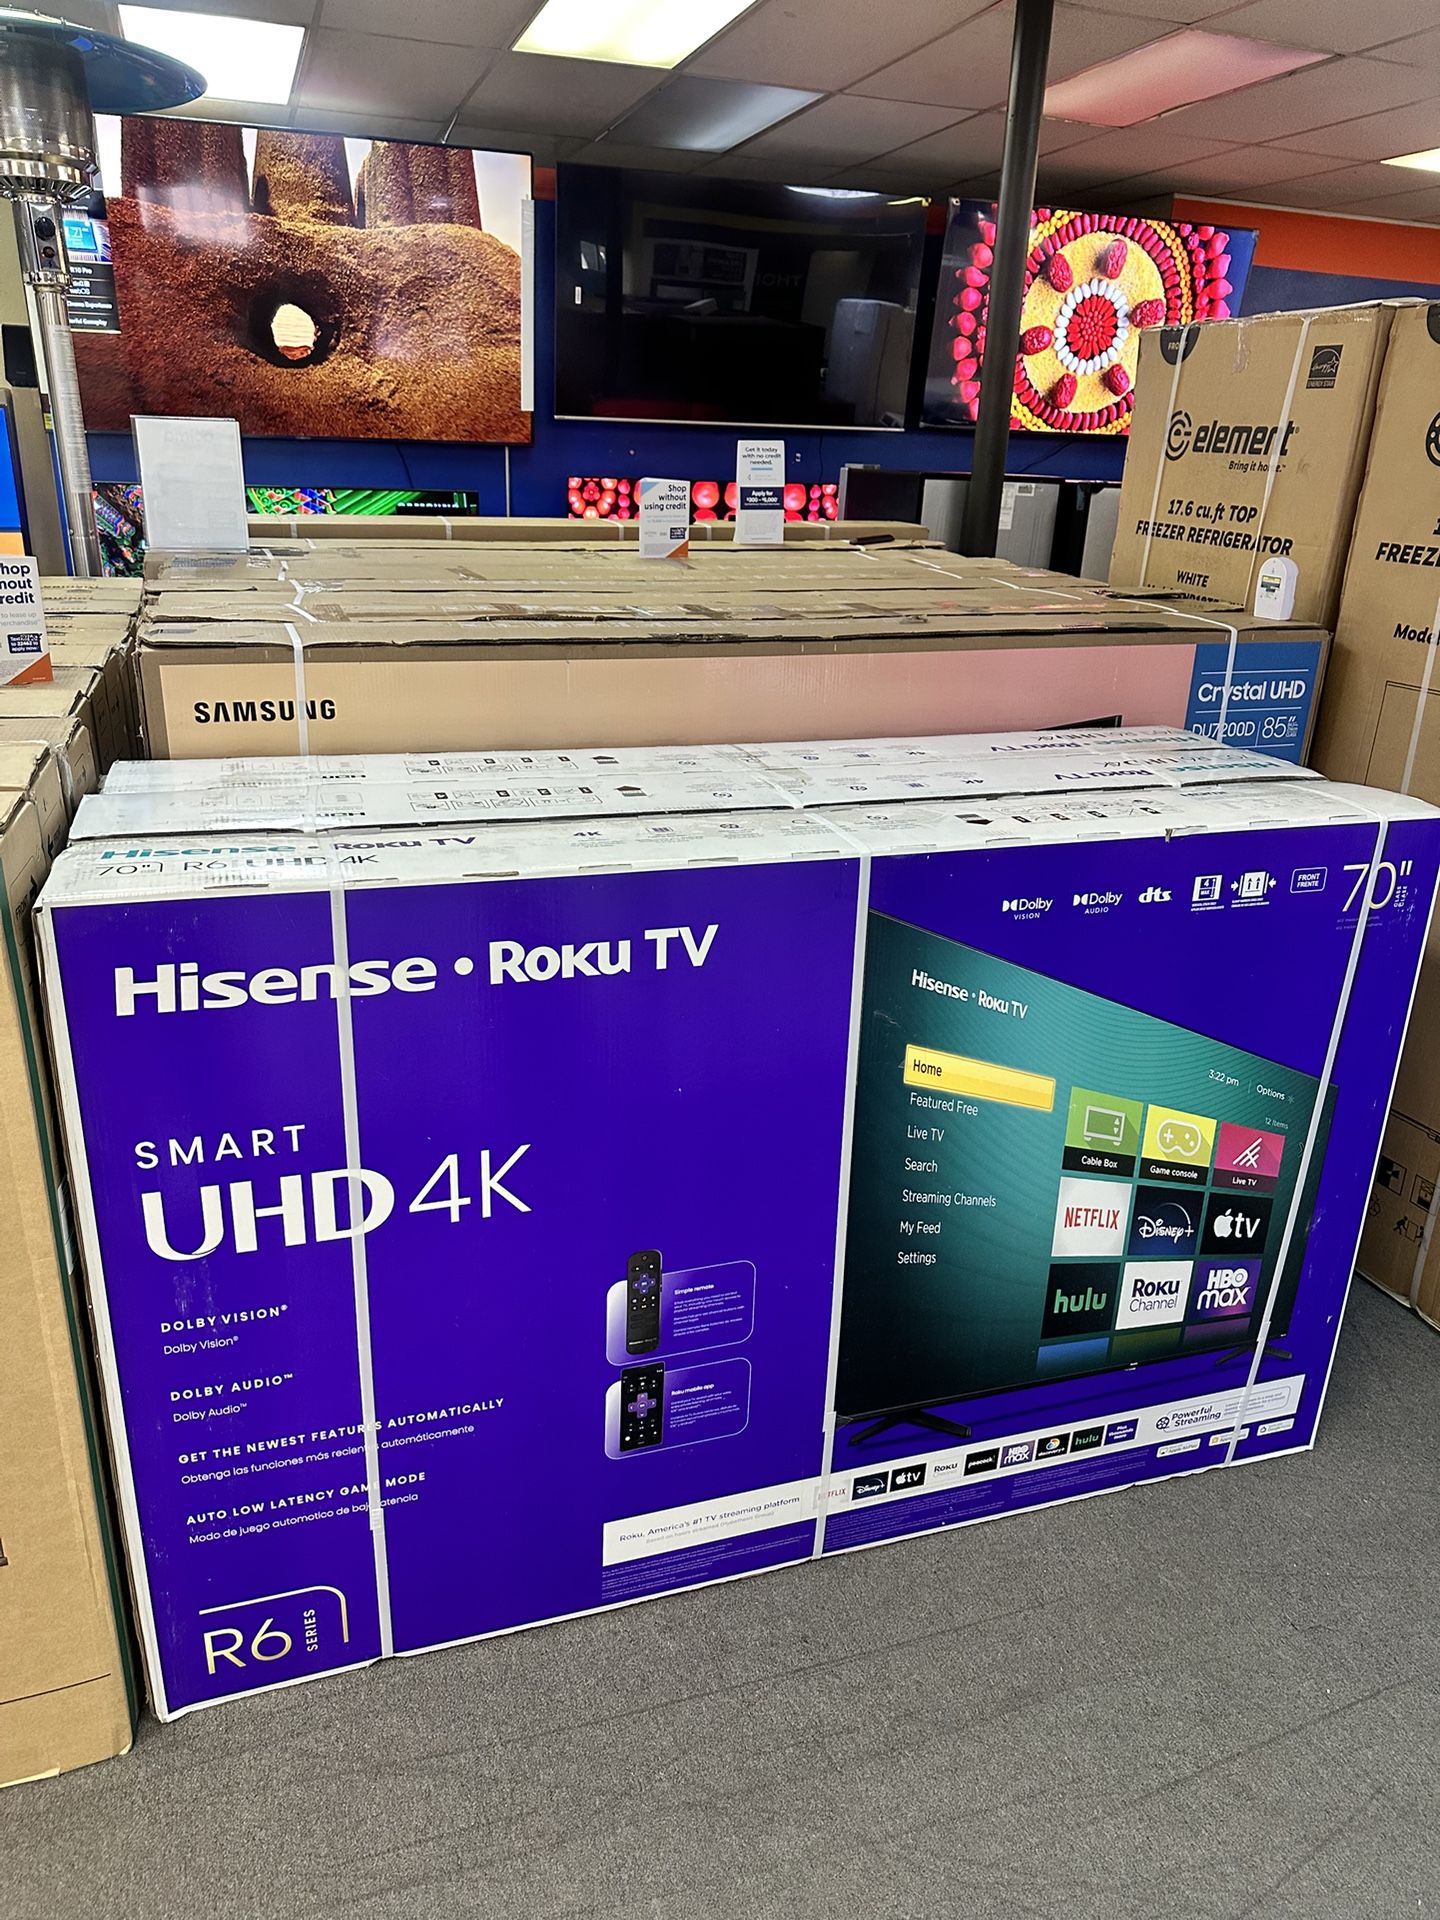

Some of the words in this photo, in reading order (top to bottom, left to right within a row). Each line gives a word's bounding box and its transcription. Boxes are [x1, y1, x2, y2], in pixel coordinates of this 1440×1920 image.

[1229, 460, 1249, 473] Bring
[658, 493, 687, 501] without
[668, 484, 687, 494] Shop
[644, 502, 664, 511] using
[666, 502, 687, 510] credit
[1168, 499, 1194, 516] 17.6
[1196, 503, 1225, 524] cu.ft
[1228, 505, 1258, 523] TOP
[1136, 520, 1184, 541] FREEZER
[1186, 527, 1293, 555] REFRIGERATOR
[1177, 570, 1209, 587] WHITE
[1197, 681, 1267, 702] Crystal
[1269, 680, 1306, 699] UHD
[193, 699, 337, 724] SAMSUNG
[1192, 721, 1256, 739] DU7200D
[1091, 769, 1154, 778] Roku
[1166, 762, 1280, 773] Hisense
[101, 845, 296, 860] Hisense
[334, 840, 422, 850] Roku
[428, 837, 476, 846] TV
[183, 860, 228, 871] R6
[246, 857, 327, 868] UHD
[339, 854, 379, 864] 4K
[1298, 873, 1321, 882] FRONT
[1342, 860, 1413, 912] 70"
[1019, 898, 1053, 912] Dolby
[1089, 892, 1123, 907] Dolby
[1138, 887, 1172, 903] dts
[1203, 879, 1210, 887] 4
[1297, 880, 1319, 888] FRENTE
[1013, 913, 1041, 921] VISION
[1084, 907, 1109, 915] AUDIO
[114, 956, 437, 1017] Hisense
[489, 940, 631, 985] Roku
[644, 924, 719, 970] TV
[911, 969, 969, 1002] Hisense
[978, 990, 1009, 1014] Roku
[1011, 1000, 1028, 1019] TV
[913, 1059, 942, 1077] Home
[1208, 1068, 1225, 1083] 3:22
[1226, 1075, 1240, 1087] pm
[1256, 1084, 1285, 1101] Options
[910, 1092, 954, 1112] Featured
[956, 1100, 979, 1116] Free
[1265, 1117, 1271, 1125] 12
[907, 1125, 928, 1140] Live
[931, 1127, 945, 1142] TV
[135, 1124, 306, 1170] SMART
[904, 1157, 938, 1173] Search
[1081, 1155, 1102, 1168] Cable
[1103, 1157, 1118, 1169] Box
[1150, 1164, 1170, 1177] Game
[1171, 1168, 1199, 1180] console
[1232, 1176, 1244, 1186] Live
[1245, 1177, 1257, 1187] TV
[141, 1167, 396, 1262] UHD
[408, 1143, 533, 1224] 4K
[902, 1189, 951, 1207] Streaming
[953, 1192, 996, 1207] Channels
[1064, 1206, 1121, 1230] NETFLIX
[1234, 1212, 1261, 1239] tv
[899, 1220, 914, 1235] My
[916, 1221, 941, 1234] Feed
[1137, 1216, 1194, 1244] Disney+
[897, 1251, 936, 1266] Settings
[1132, 1278, 1182, 1298] Roku
[1206, 1268, 1249, 1290] HBO
[674, 1285, 694, 1296] Simple
[694, 1283, 715, 1293] remote
[1196, 1286, 1251, 1311] max
[1053, 1287, 1107, 1314] hulu
[1129, 1292, 1178, 1313] Channel
[160, 1315, 217, 1334] DOLBY
[163, 1340, 198, 1356] Dolby
[169, 1383, 225, 1402] DOLBY
[172, 1407, 207, 1423] Dolby
[1171, 1405, 1213, 1421] Powerful
[1173, 1411, 1221, 1428] Streaming
[178, 1451, 208, 1465] GET
[213, 1446, 241, 1459] THE
[246, 1434, 306, 1453] NEWEST
[387, 1398, 505, 1429] AUTOMATICALLY
[1075, 1433, 1099, 1446] hulu
[181, 1468, 231, 1485] Obtenga
[232, 1466, 249, 1476] las
[250, 1456, 304, 1474] funciones
[306, 1451, 329, 1463] más
[381, 1424, 475, 1450] automáticamente
[1003, 1453, 1030, 1465] max
[1008, 1444, 1029, 1456] HBO
[934, 1462, 958, 1473] Roku
[967, 1456, 993, 1469] peacock
[855, 1478, 886, 1494] Disney+
[186, 1510, 227, 1526] AUTO
[232, 1502, 265, 1517] LOW
[270, 1488, 335, 1510] LATENCY
[385, 1471, 426, 1488] MODE
[189, 1530, 221, 1544] Modo
[223, 1527, 238, 1538] de
[239, 1520, 270, 1536] juego
[336, 1506, 350, 1516] de
[619, 1531, 646, 1542] Roku,
[648, 1520, 691, 1536] America's
[692, 1516, 703, 1526] #1
[705, 1513, 717, 1522] TV
[719, 1503, 762, 1521] streaming
[763, 1496, 800, 1511] platform
[303, 1608, 319, 1652] SERIES
[203, 1617, 293, 1675] R6
